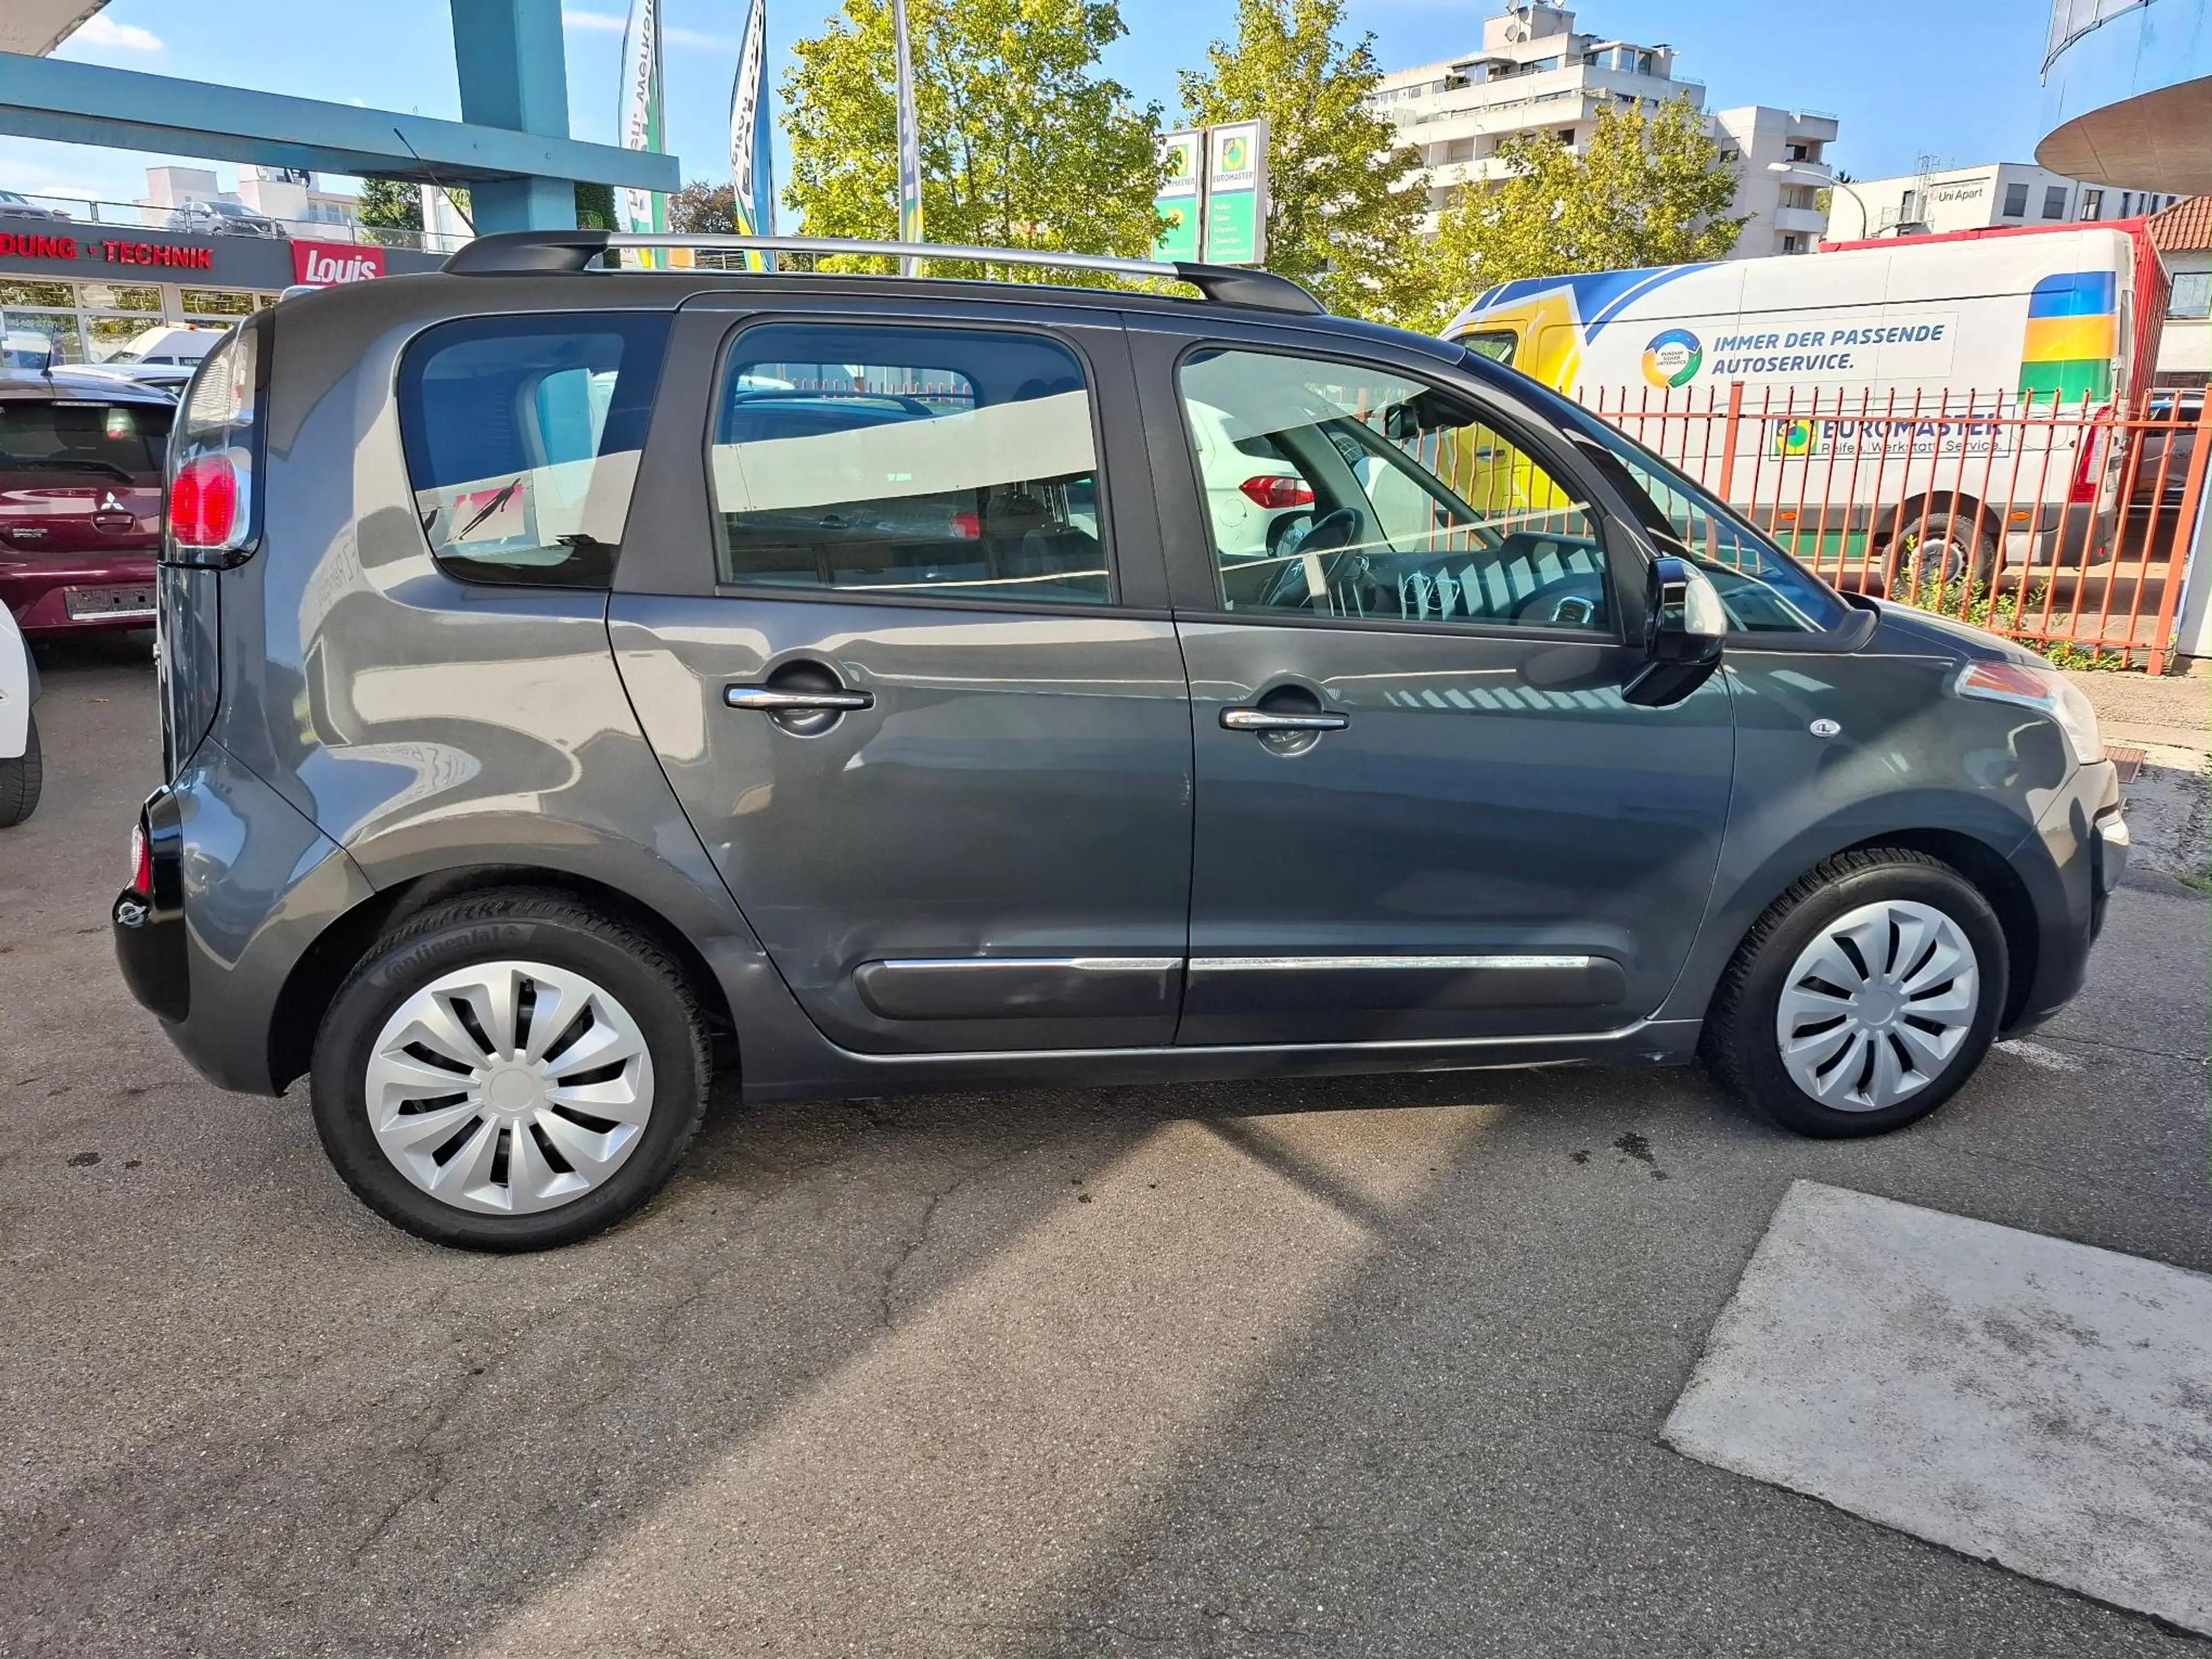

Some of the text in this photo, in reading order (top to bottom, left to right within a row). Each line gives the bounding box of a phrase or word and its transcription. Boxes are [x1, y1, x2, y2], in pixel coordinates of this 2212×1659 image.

[1213, 171, 1253, 183] EUROMASTER
[1939, 187, 1983, 202] Uni Apart
[101, 240, 213, 269] TECHNIK
[306, 250, 376, 283] Louis
[1713, 324, 1945, 352] IMMER DER PASSENDE
[1711, 353, 1854, 375] AUTOSERVICE.
